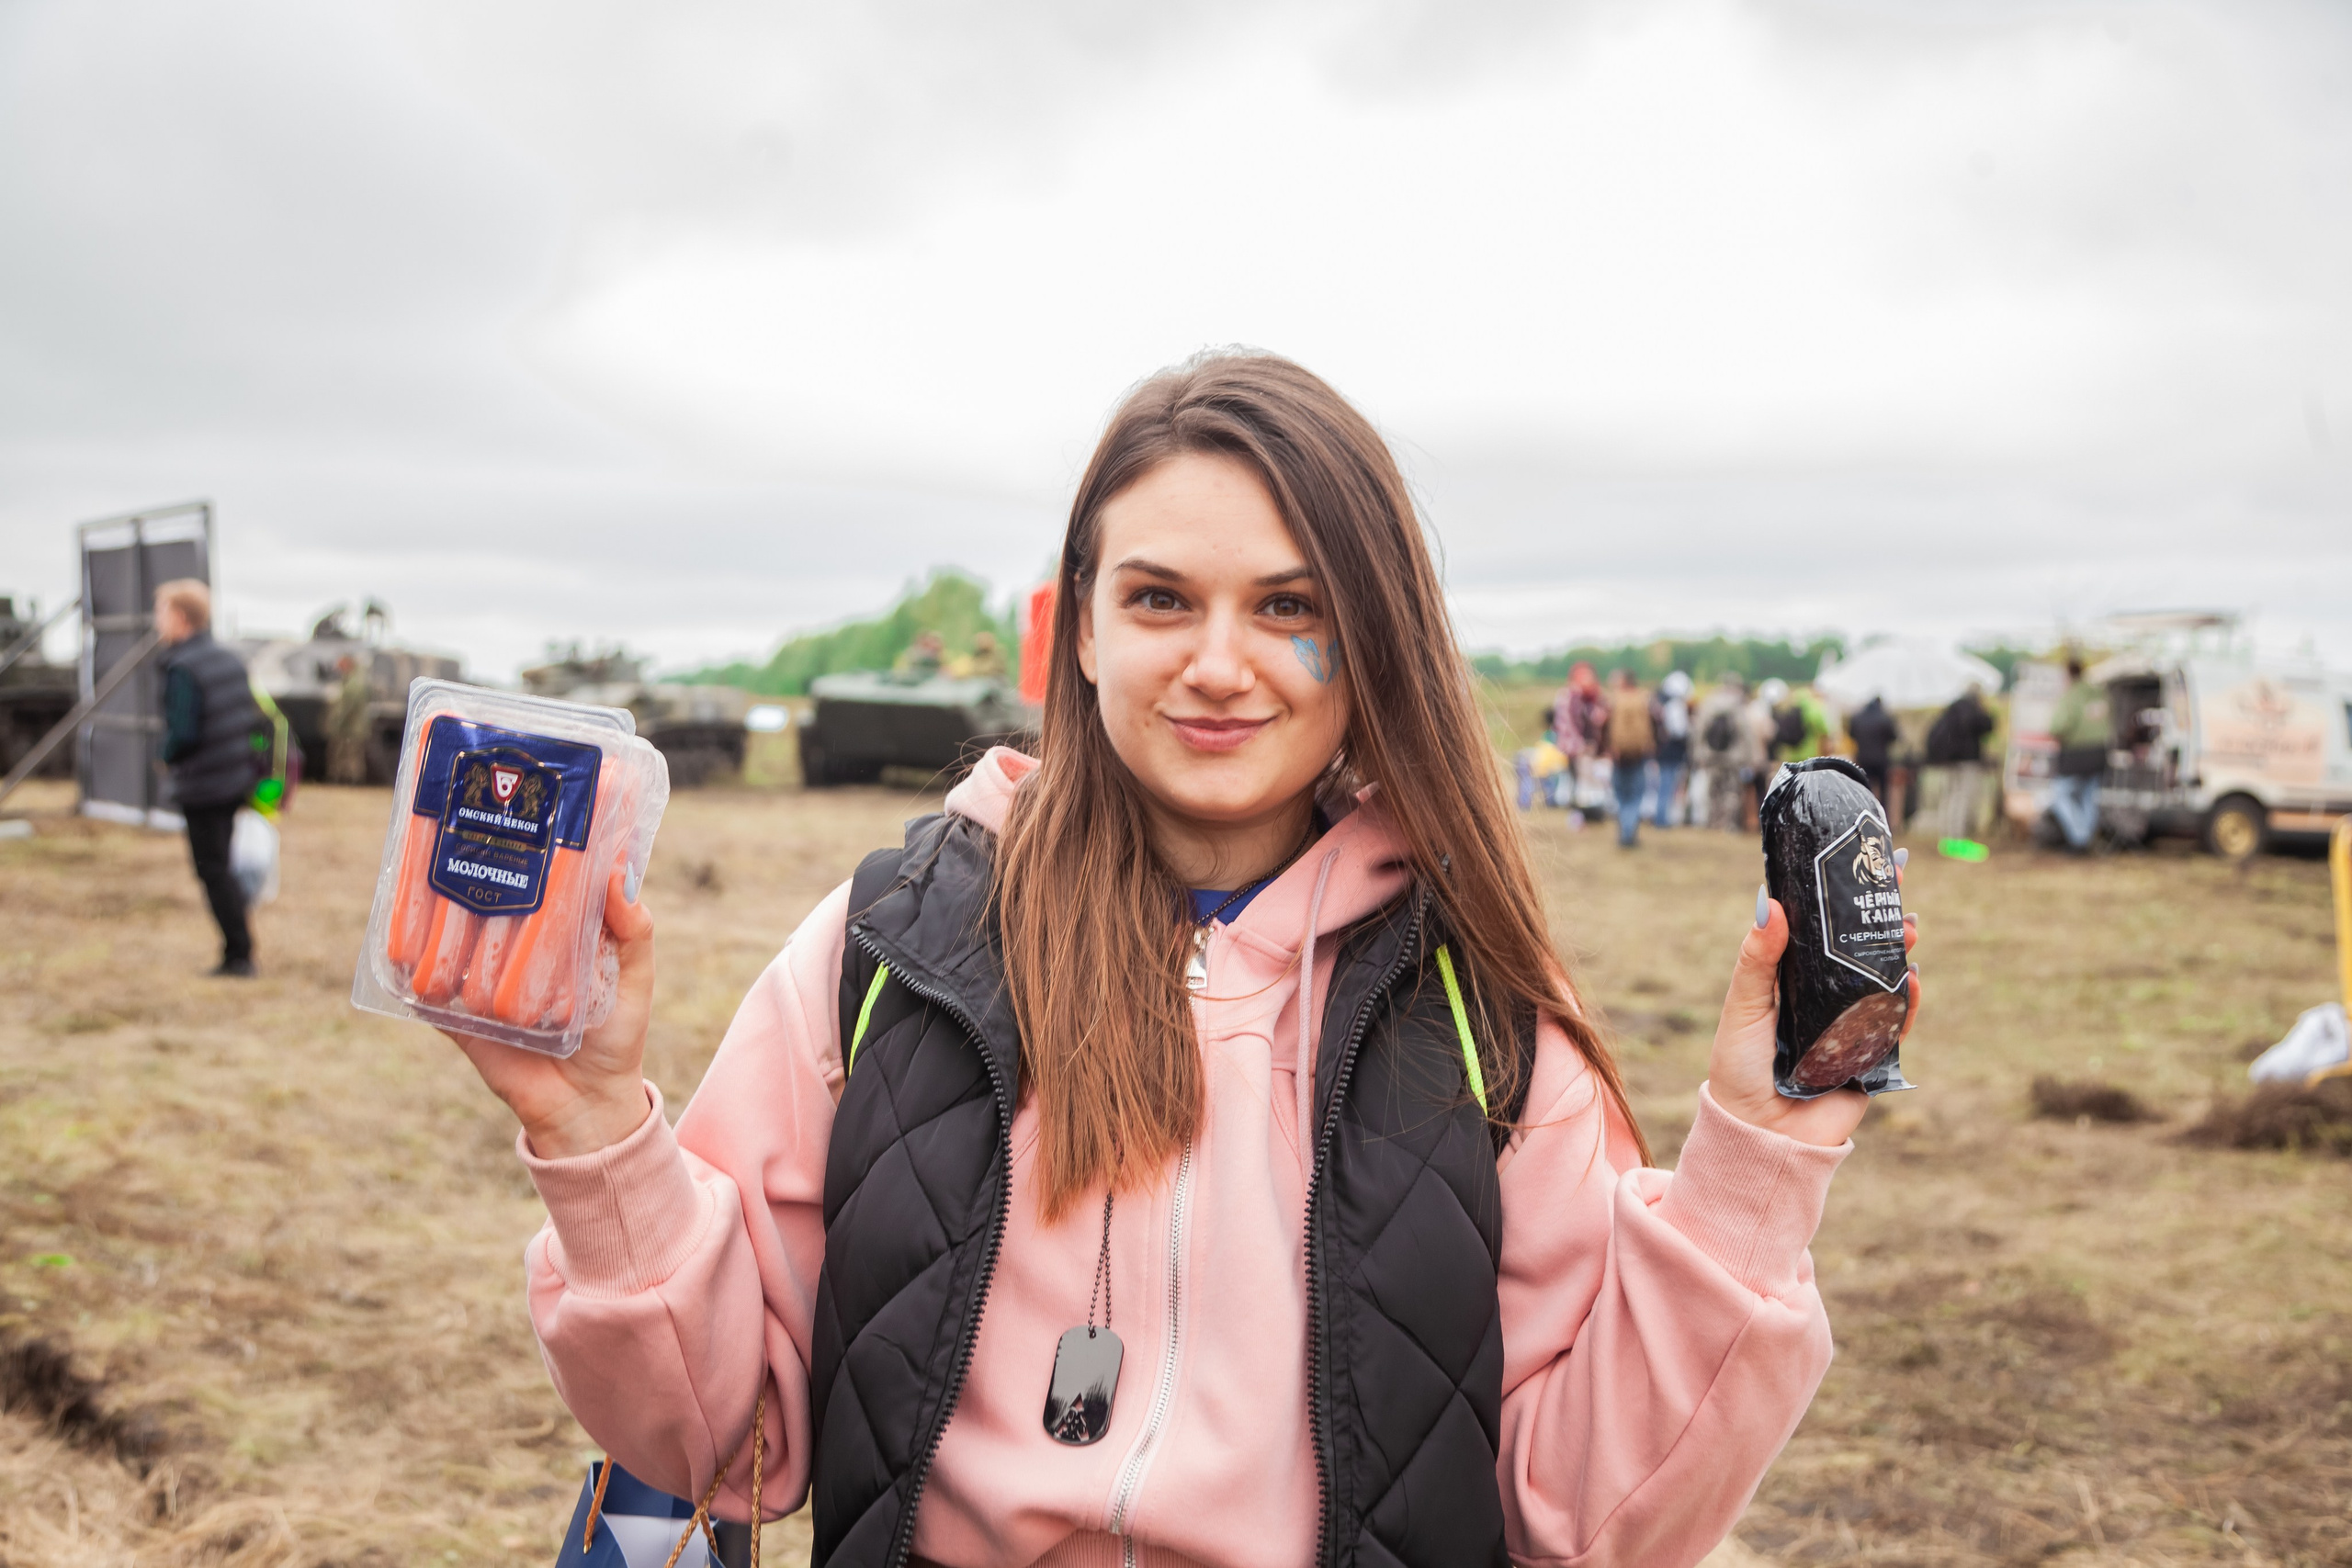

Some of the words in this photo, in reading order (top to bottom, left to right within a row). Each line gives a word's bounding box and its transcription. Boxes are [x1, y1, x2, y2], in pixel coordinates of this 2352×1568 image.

[458, 807, 503, 825] ОМСКИЙ
[503, 816, 539, 833] БЕКОН
[447, 857, 529, 890] МОЛОЧНЫЕ
[467, 886, 503, 904] ГОСТ
[1853, 888, 1902, 909] ЧЁРНЫЙ
[1839, 933, 1849, 943] С
